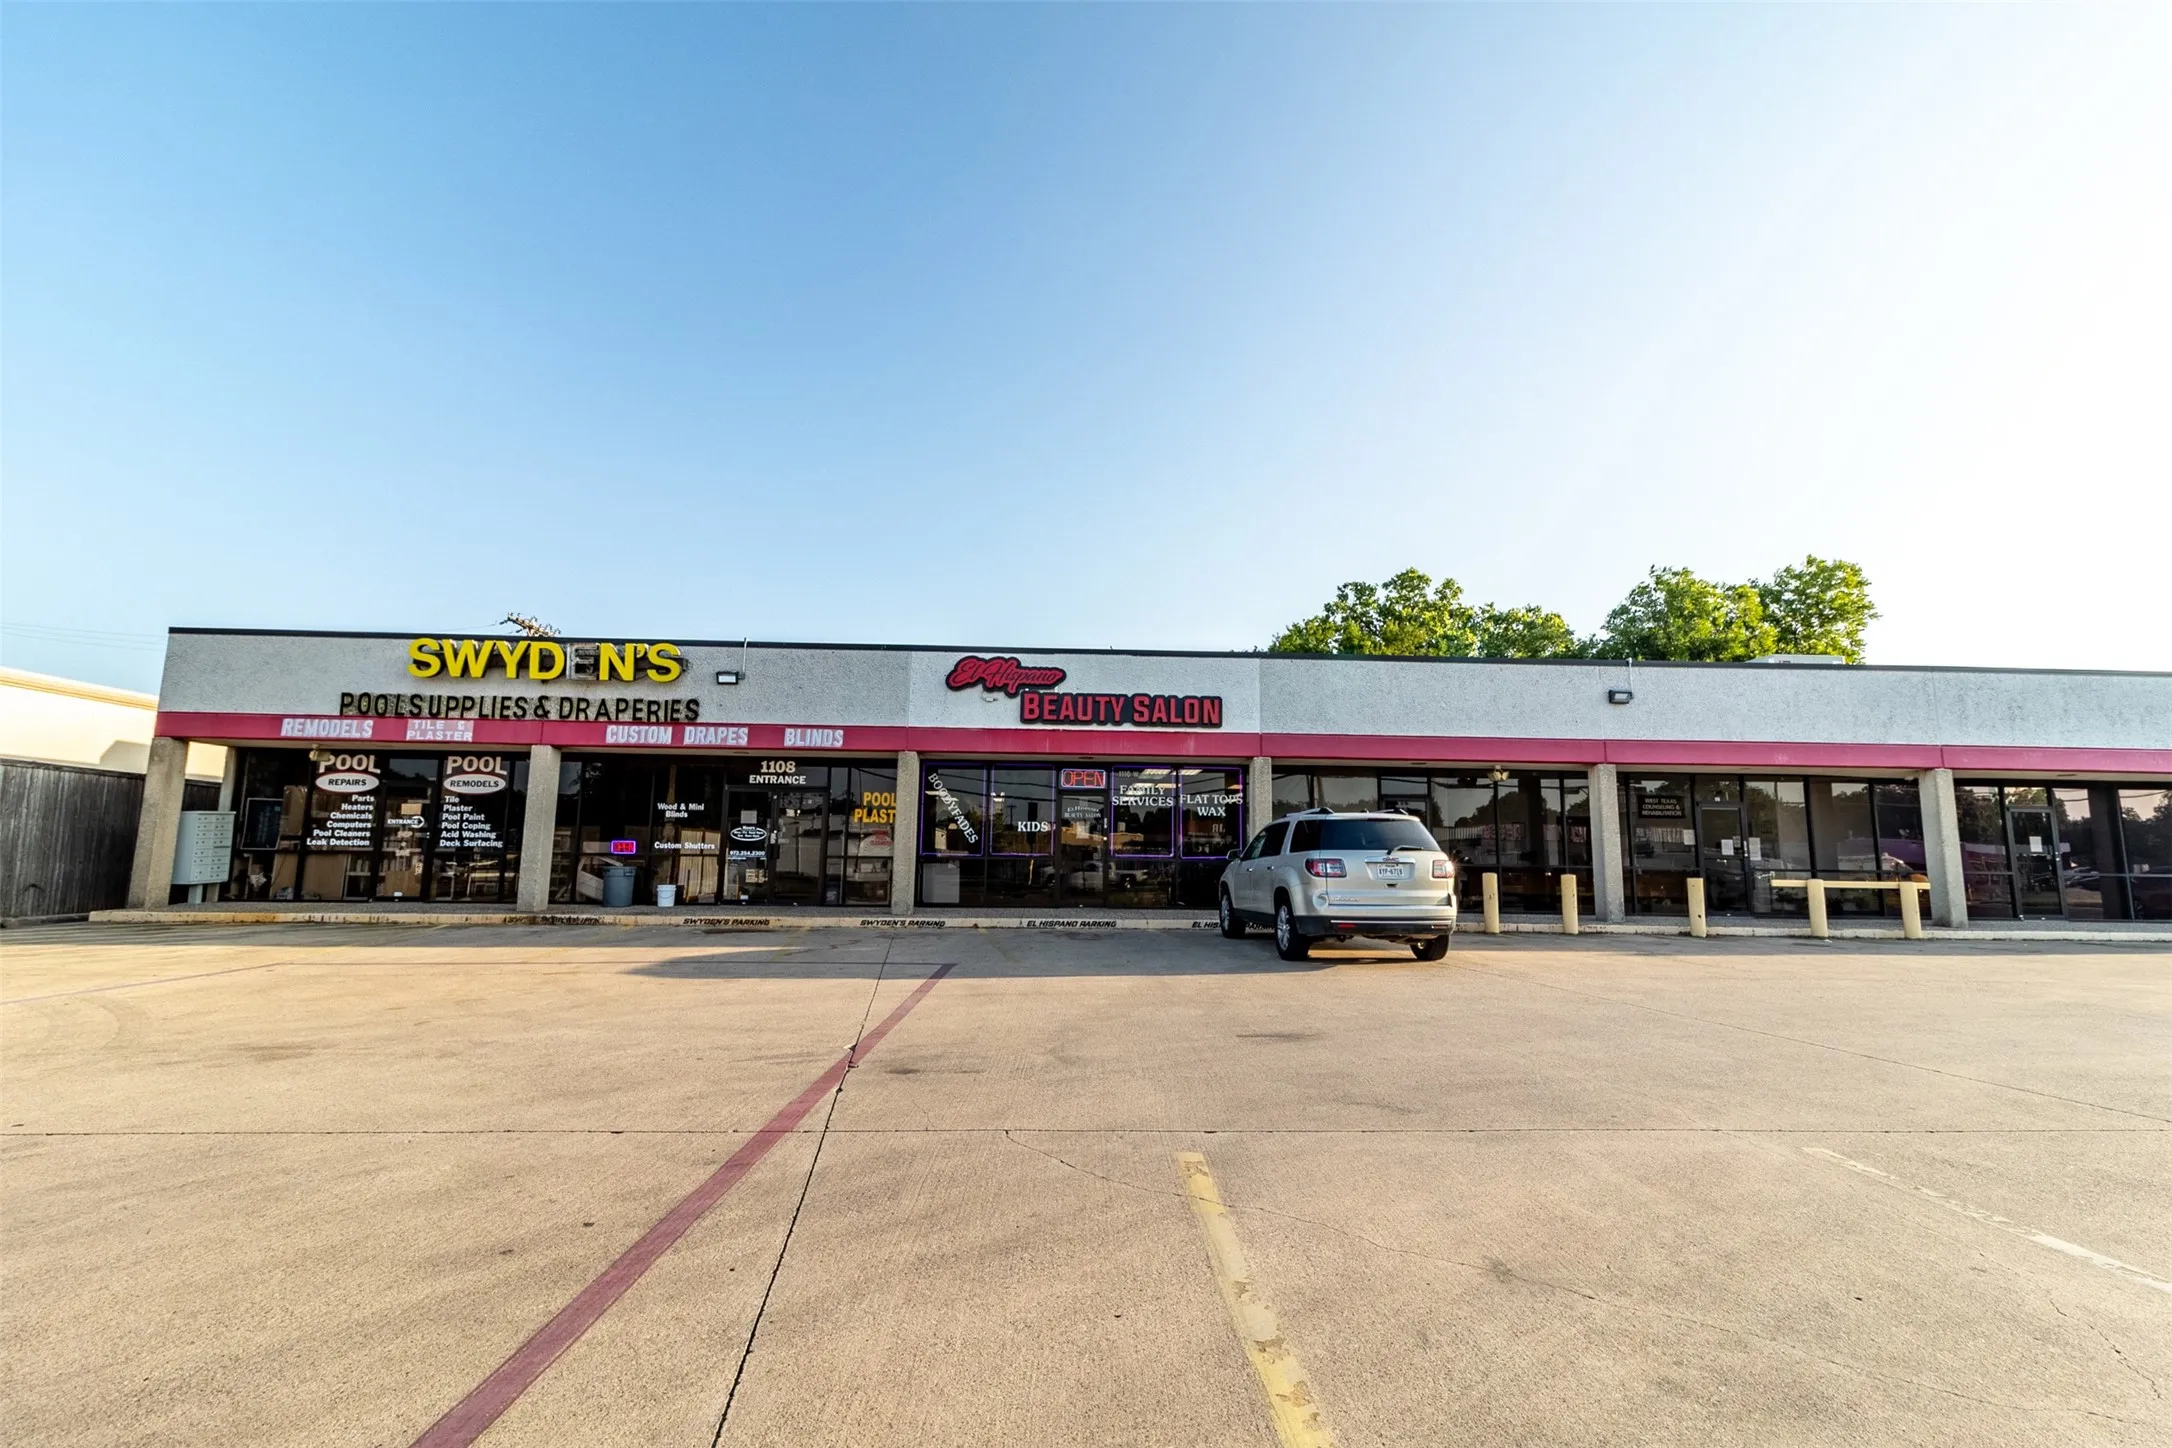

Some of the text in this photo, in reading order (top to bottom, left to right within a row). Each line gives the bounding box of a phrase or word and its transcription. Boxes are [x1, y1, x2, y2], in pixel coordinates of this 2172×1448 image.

[407, 638, 682, 683] SWYDEN'S
[533, 695, 550, 719] &
[559, 696, 700, 722] DRAPERIES
[1022, 693, 1220, 725] BEAUTY SALON
[280, 718, 374, 738] REMODELS
[413, 720, 445, 730] TILE
[406, 730, 472, 741] PLASTER
[606, 725, 748, 745] CUSTOM DRAPES
[784, 728, 844, 747] BLINDS
[318, 754, 381, 774] POOL
[446, 756, 507, 775] POOL
[760, 760, 796, 773] 1108
[328, 778, 367, 787] REPAIRS
[749, 775, 807, 784] ENTRANCE
[1063, 770, 1105, 787] OPEN
[450, 779, 500, 788] REMODELS
[1119, 784, 1166, 795] FAMILY
[351, 794, 375, 802] Parts
[863, 791, 896, 807] POOL
[1112, 795, 1174, 807] SERVICES
[1180, 793, 1243, 805] FLAT TOPS
[341, 803, 374, 811] Heaters
[443, 804, 473, 812] Plaster
[657, 803, 705, 811] Wood & Mini
[1197, 806, 1227, 817] WAX
[330, 812, 373, 820] Chemicals
[442, 813, 486, 821] Pool Paint
[854, 808, 896, 824] PLAST
[326, 820, 372, 829] Computers
[462, 822, 492, 831] Coping
[1017, 821, 1049, 833] KIDS
[313, 829, 371, 837] Pool Cleaners
[440, 830, 497, 839] Acid Washing
[306, 838, 370, 846] Leak Detection
[439, 839, 504, 848] Deck Surfacing
[654, 841, 682, 849] Custom
[683, 918, 770, 926] SWYDEN'S PARKING
[860, 919, 906, 927] SWYDEN'S
[1079, 920, 1117, 928] PARKING
